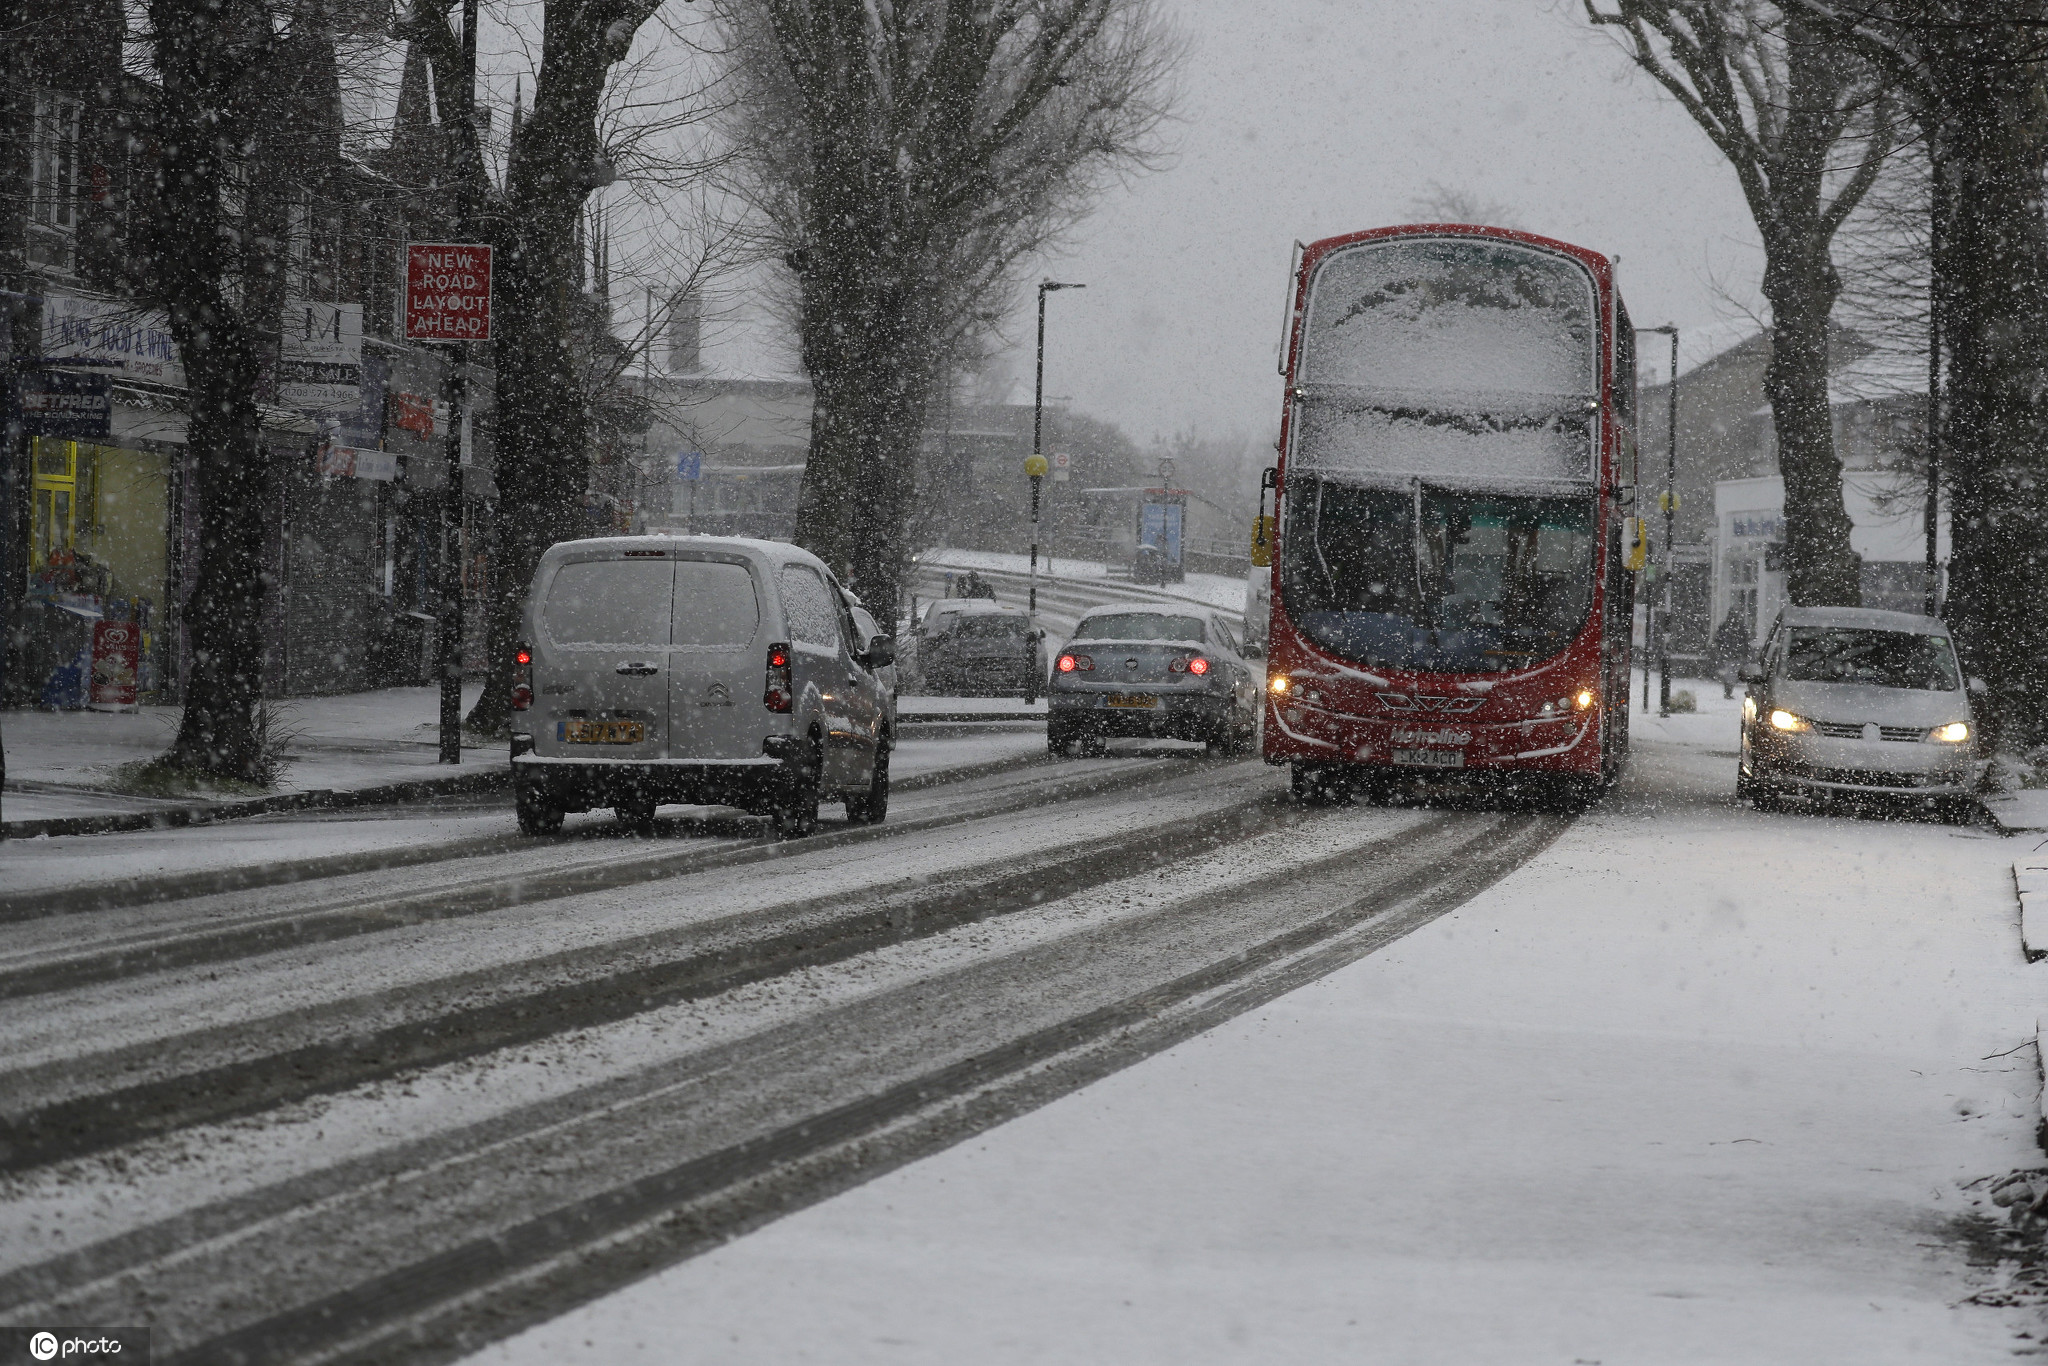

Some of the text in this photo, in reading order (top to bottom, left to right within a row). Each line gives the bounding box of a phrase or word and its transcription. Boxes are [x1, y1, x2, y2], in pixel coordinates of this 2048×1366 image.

[429, 253, 472, 268] NEW
[423, 274, 476, 290] ROAD
[413, 295, 487, 311] LAYOUT
[415, 316, 481, 332] AHEAD
[147, 328, 174, 361] WINE
[318, 367, 354, 381] SALE
[24, 393, 106, 410] BETFRED
[80, 412, 104, 420] KING
[1389, 727, 1471, 746] Metroline
